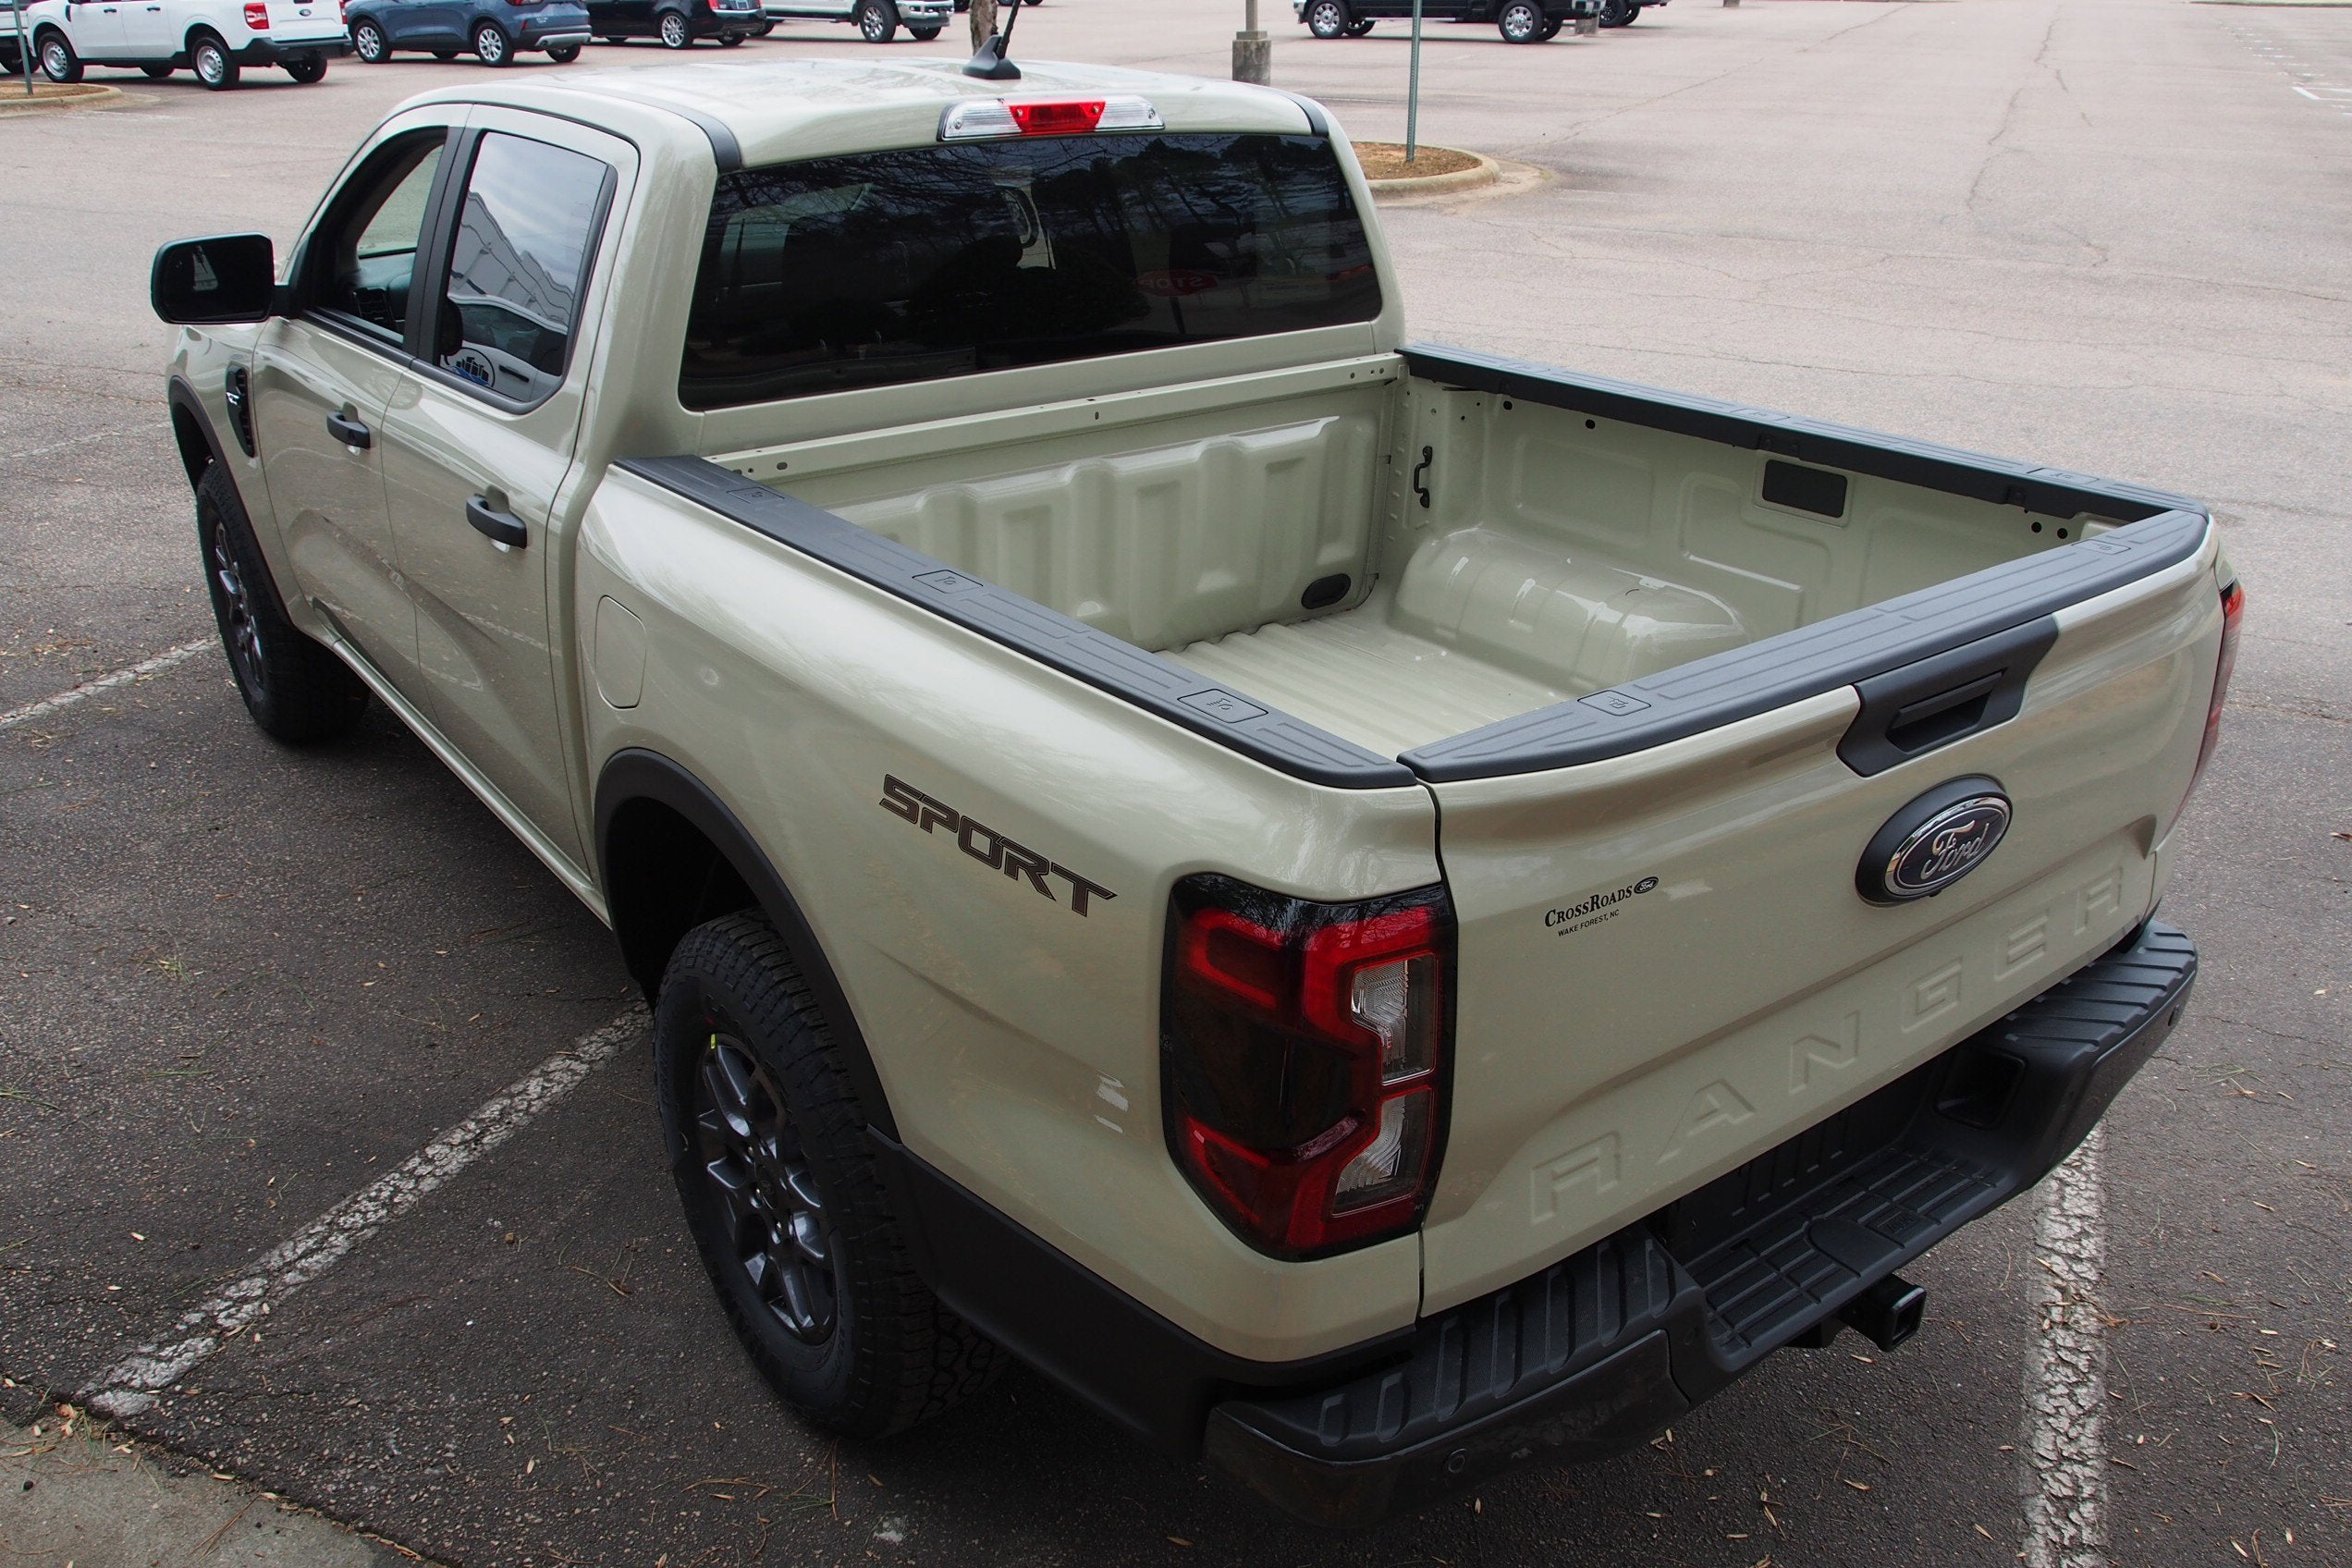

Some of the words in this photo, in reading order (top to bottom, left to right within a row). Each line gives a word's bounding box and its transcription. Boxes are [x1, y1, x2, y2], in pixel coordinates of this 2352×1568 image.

[879, 774, 1118, 917] SPORT
[1920, 820, 1990, 880] Ford
[1558, 925, 1579, 937] WAKE
[1580, 913, 1609, 930] FOREST,
[1610, 909, 1620, 919] NC
[1530, 865, 2124, 1225] RANGER
